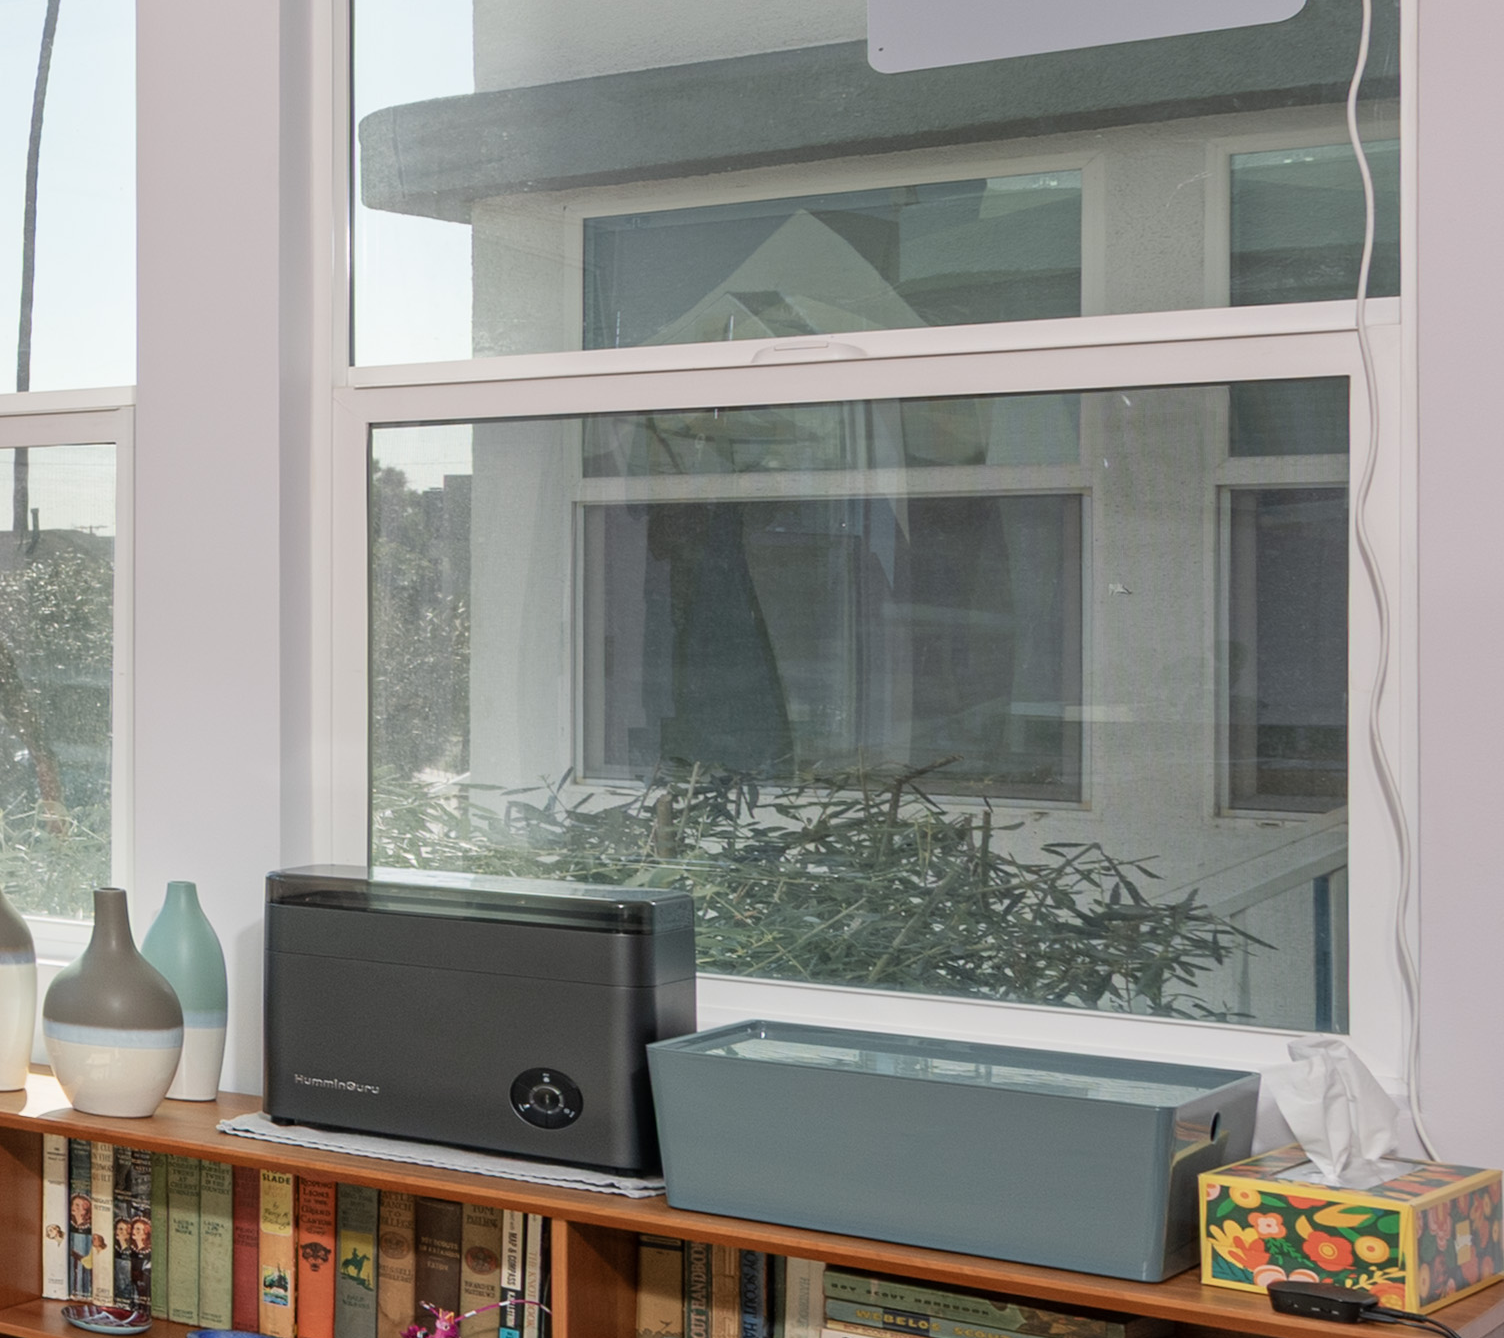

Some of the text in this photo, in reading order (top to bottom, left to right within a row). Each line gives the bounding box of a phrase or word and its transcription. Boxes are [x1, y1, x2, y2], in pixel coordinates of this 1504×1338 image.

[294, 1072, 381, 1096] HumminGuru
[261, 1172, 291, 1186] SLADE
[506, 1231, 517, 1286] MAP COMPASS
[743, 1273, 757, 1316] SCOUT
[831, 1281, 857, 1295] BOY
[865, 1288, 907, 1302] SCOUT
[854, 1307, 941, 1332] WEBELOS
